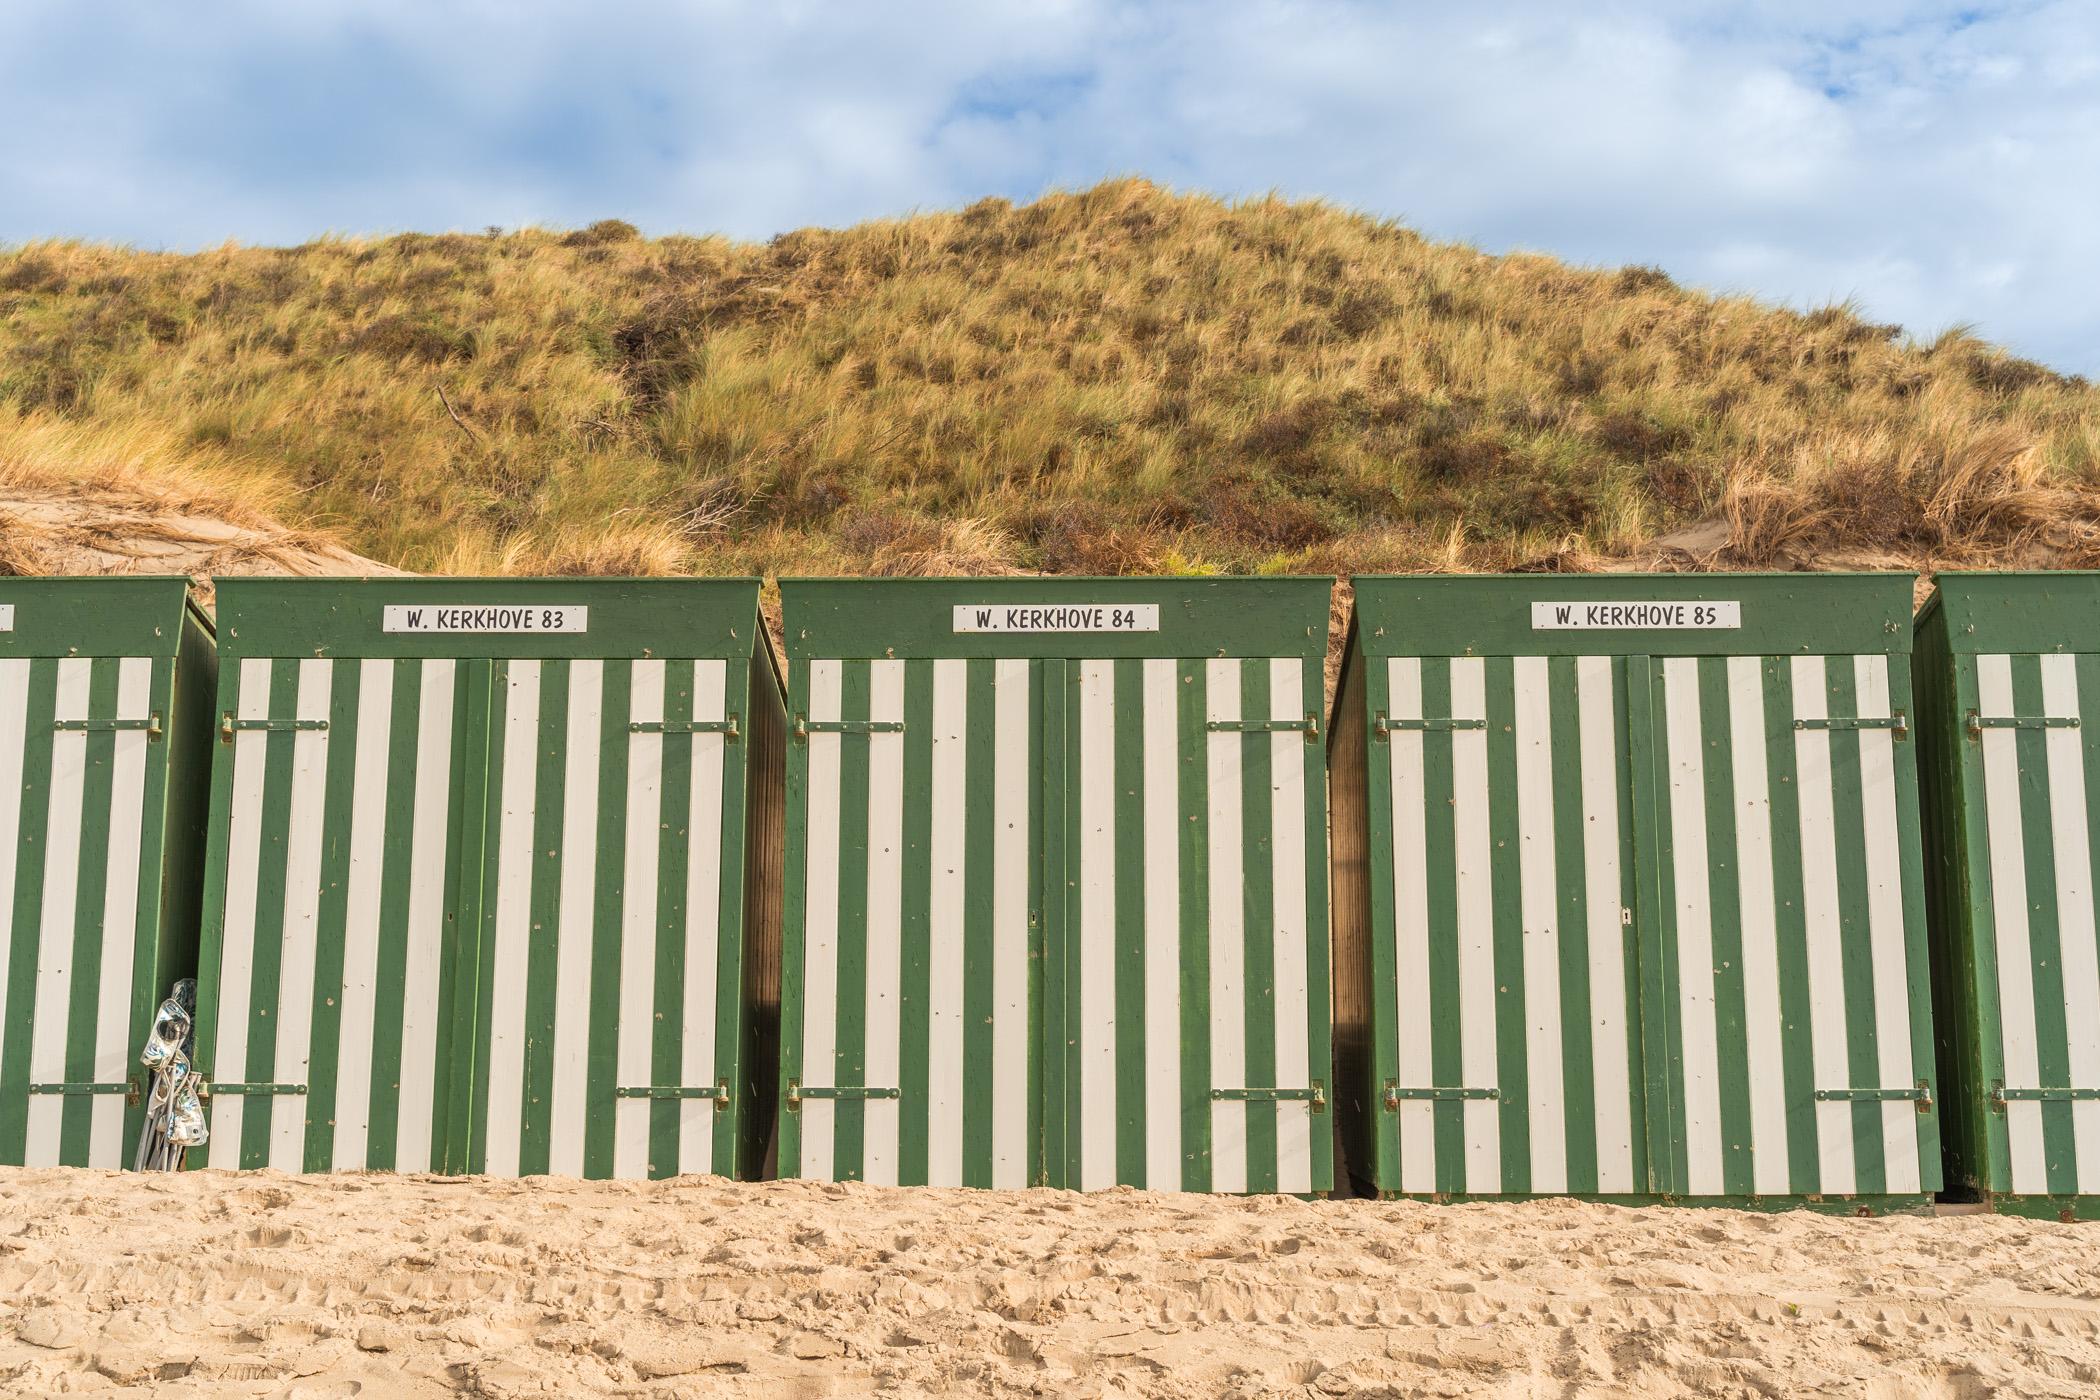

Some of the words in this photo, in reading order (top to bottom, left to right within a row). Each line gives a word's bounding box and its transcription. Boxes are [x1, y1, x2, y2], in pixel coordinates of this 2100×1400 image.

[407, 609, 428, 629] W.
[437, 608, 533, 629] KERKHOVE
[541, 609, 564, 629] 83
[976, 608, 998, 629] W.
[1006, 607, 1103, 629] KERKHOVE
[1111, 609, 1136, 629] 84
[1555, 605, 1578, 626] W.
[1587, 604, 1685, 626] KERKHOVE
[1693, 606, 1717, 626] 85
